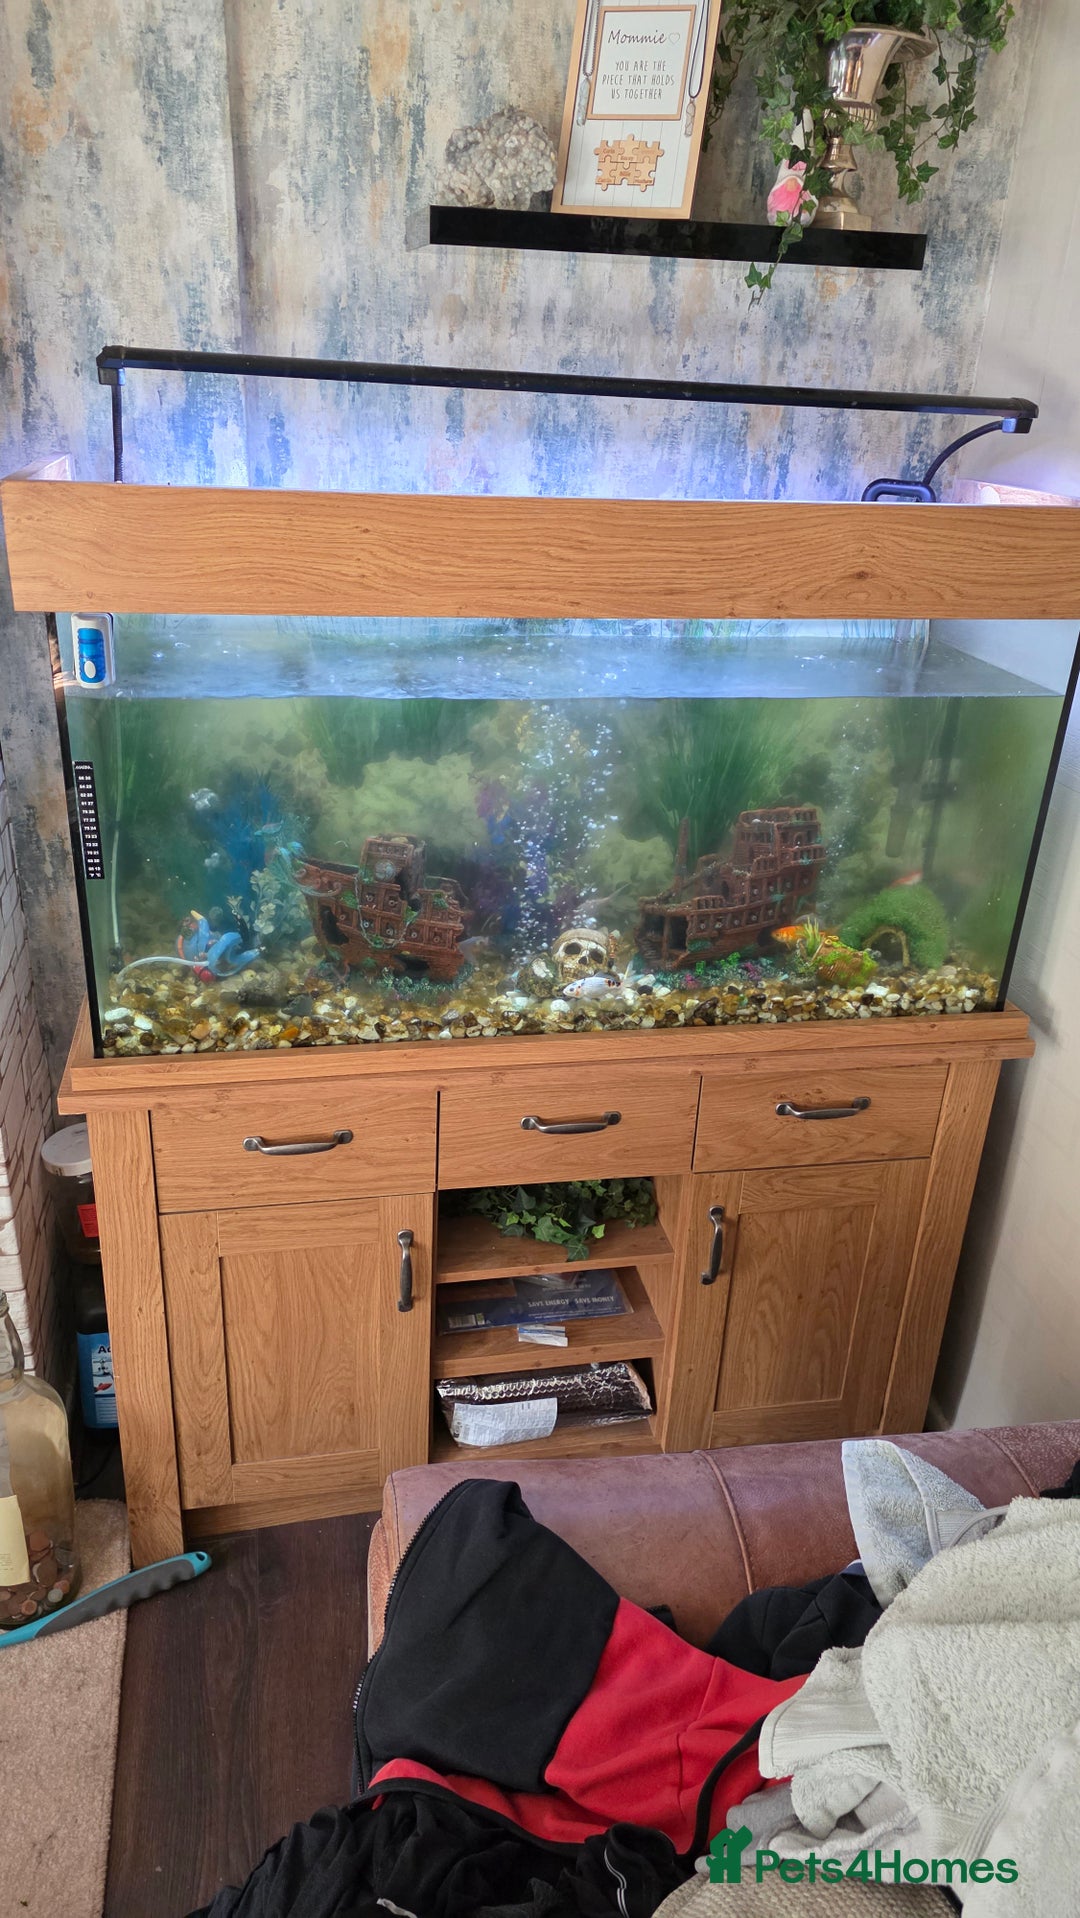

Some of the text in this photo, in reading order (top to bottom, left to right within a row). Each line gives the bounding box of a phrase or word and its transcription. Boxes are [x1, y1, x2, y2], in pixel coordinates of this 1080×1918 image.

[608, 29, 667, 44] Mommie
[616, 60, 666, 71] YOU ARE THE
[602, 74, 675, 86] PIECE THAT HOLDS
[611, 88, 662, 100] US TOGETHER
[527, 1300, 544, 1308] SAVE
